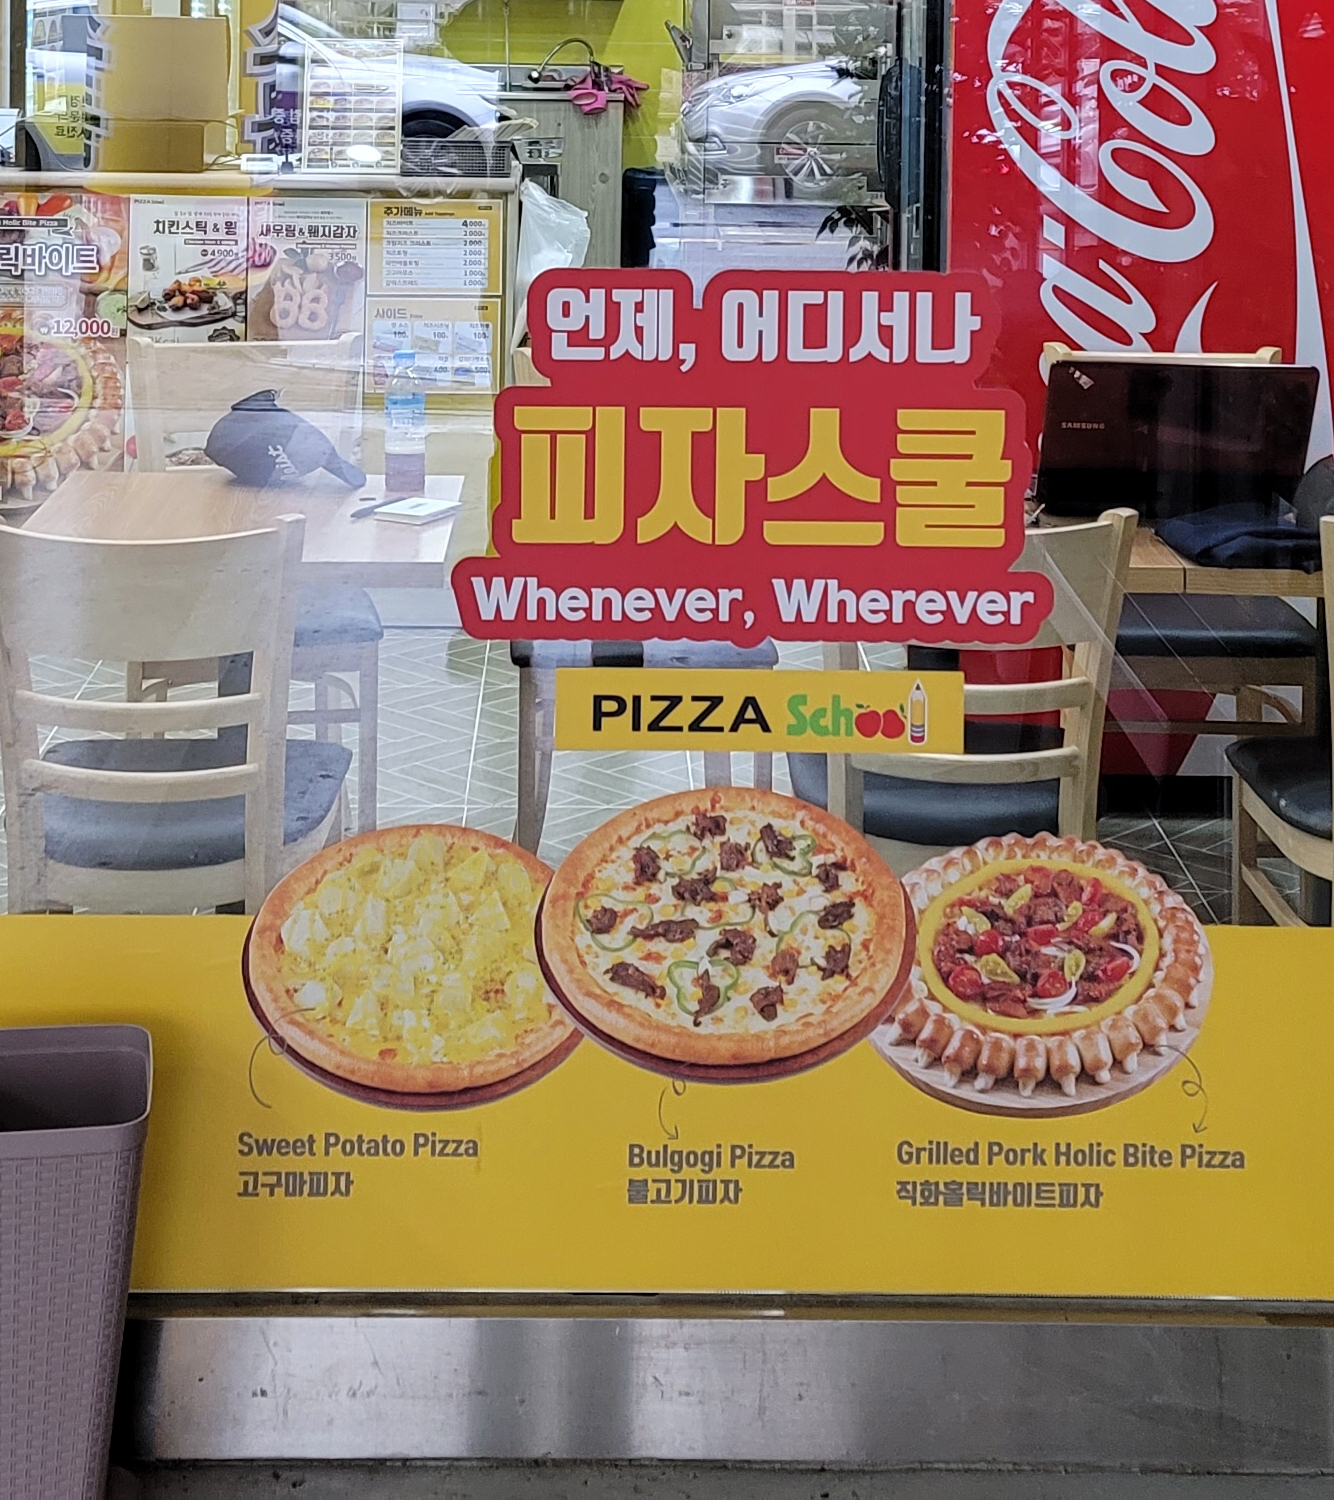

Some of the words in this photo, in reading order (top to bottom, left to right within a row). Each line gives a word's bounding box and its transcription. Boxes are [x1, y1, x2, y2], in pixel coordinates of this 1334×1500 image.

[39, 219, 59, 227] Pizza
[384, 207, 422, 216] 추가메뉴
[154, 220, 208, 236] 치킨스틱
[212, 222, 221, 234] &
[224, 219, 238, 236] 윙
[258, 224, 296, 238] 새우링
[298, 228, 306, 237] &
[374, 308, 408, 319] 사이드
[545, 287, 697, 373] 언제,
[720, 290, 982, 365] 어디서나
[1061, 421, 1106, 429] SAMSUNG
[511, 406, 1013, 548] 피자스쿨
[469, 576, 756, 630] Whenever,
[770, 578, 1036, 626] Wherever
[591, 694, 772, 735] PIZZA
[238, 1131, 318, 1159] Sweet
[323, 1132, 406, 1160] Potato
[413, 1133, 480, 1160] Pizza
[627, 1143, 723, 1175] Bulgogi
[729, 1144, 797, 1172] Pizza
[895, 1138, 980, 1167] Grilled
[987, 1140, 1047, 1168] Pork
[1053, 1141, 1116, 1170] Holic
[1122, 1142, 1174, 1170] Bite
[1180, 1143, 1247, 1172] Pizza
[236, 1169, 355, 1200] 고구마피자
[626, 1178, 742, 1206] 불고기피자
[895, 1179, 1103, 1210] 직화홀릭바이트피자
